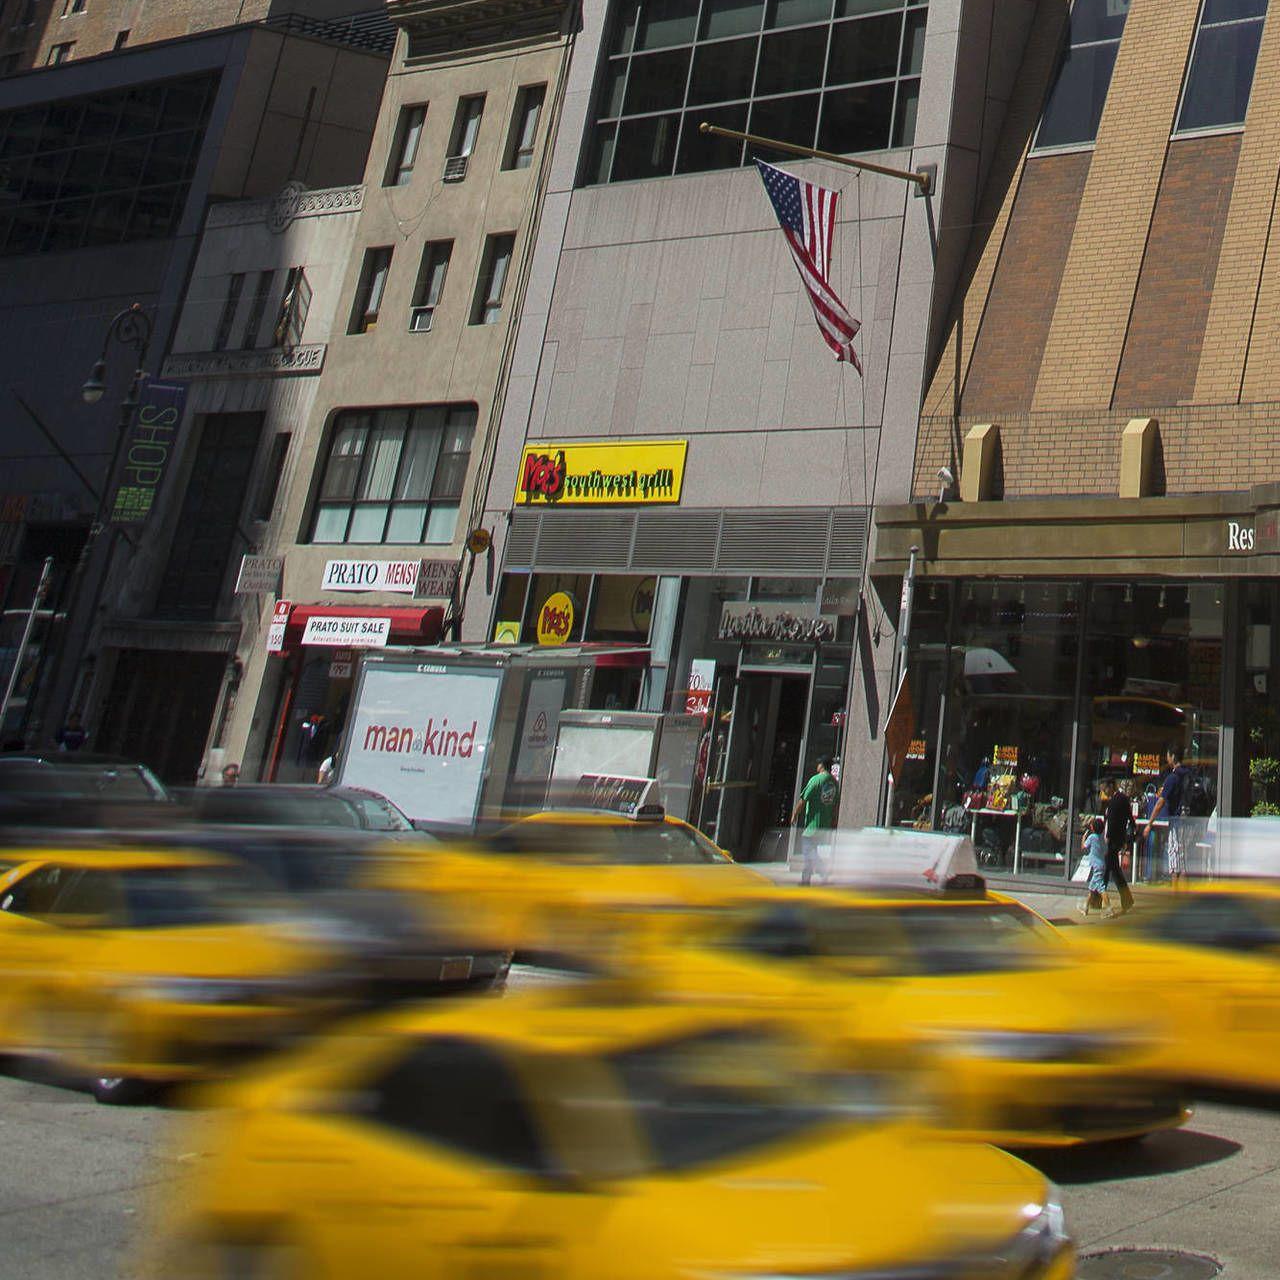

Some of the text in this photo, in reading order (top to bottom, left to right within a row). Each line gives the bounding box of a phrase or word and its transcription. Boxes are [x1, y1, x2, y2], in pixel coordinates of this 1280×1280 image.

[125, 404, 179, 485] SHOP
[564, 470, 636, 489] southwest
[638, 469, 671, 490] grill
[327, 562, 379, 585] PRATO
[418, 580, 454, 596] WEAR
[310, 620, 385, 634] PRATO SUIT SALE
[363, 717, 478, 759] man kind
